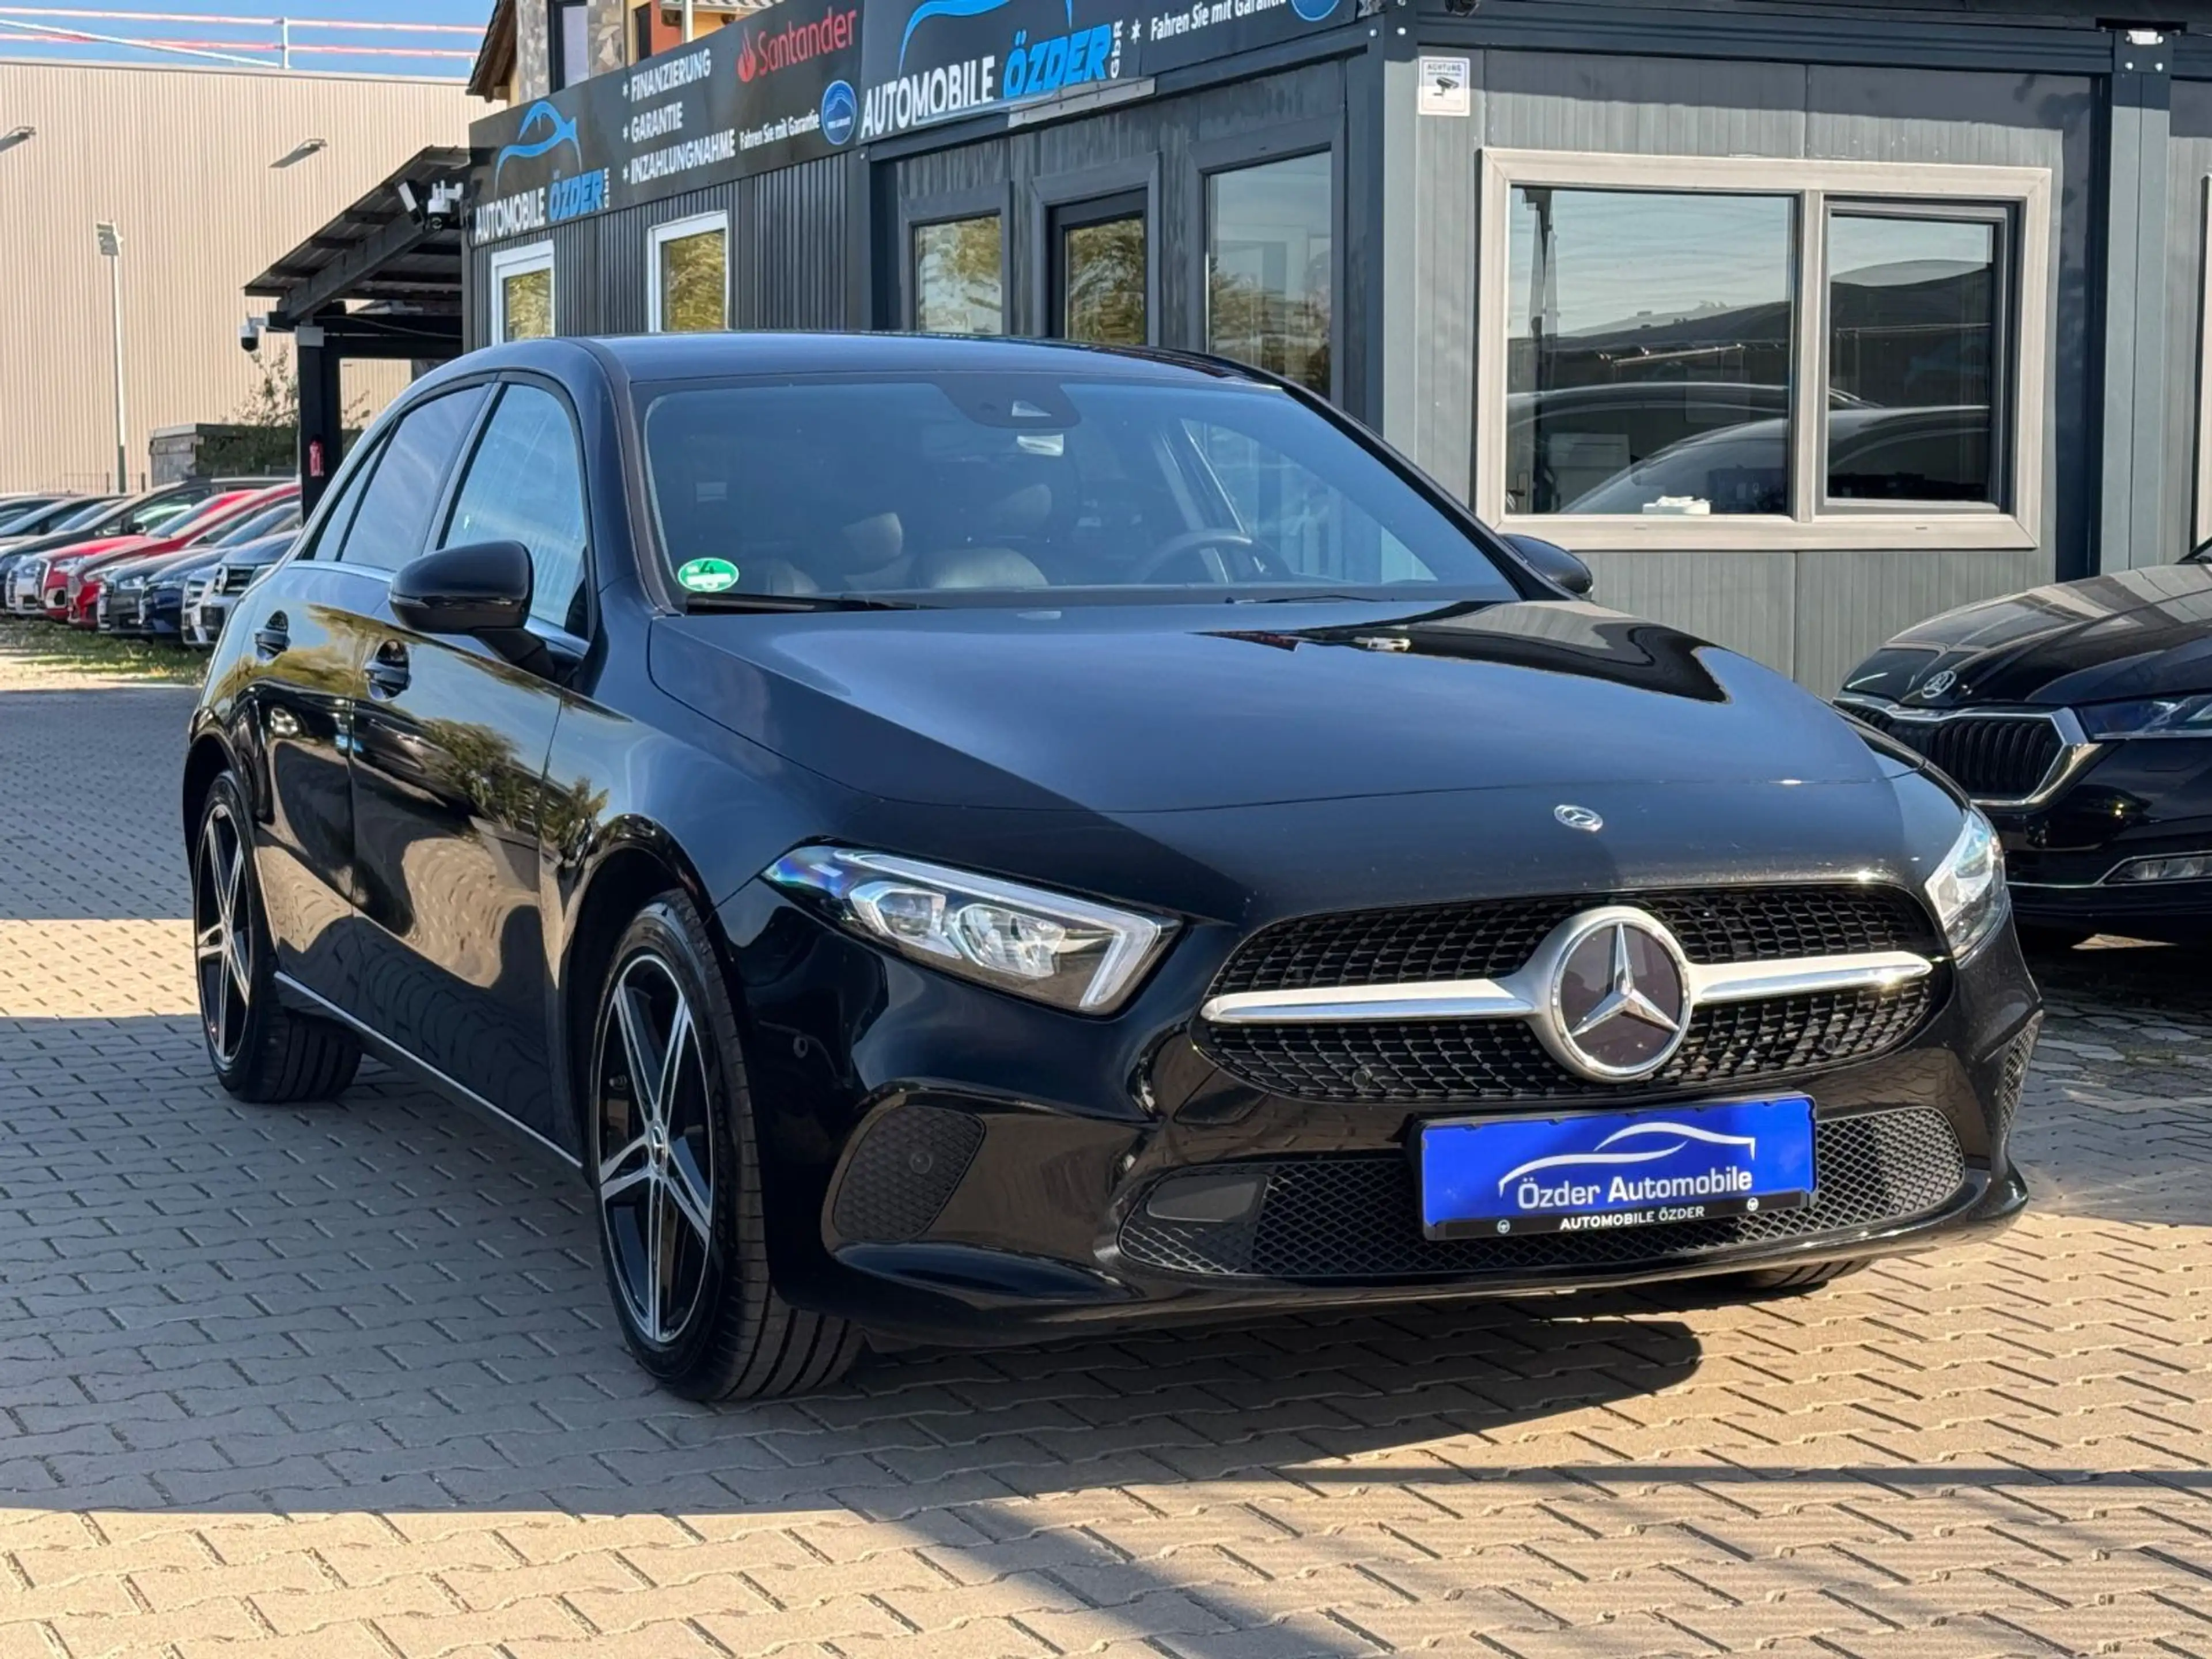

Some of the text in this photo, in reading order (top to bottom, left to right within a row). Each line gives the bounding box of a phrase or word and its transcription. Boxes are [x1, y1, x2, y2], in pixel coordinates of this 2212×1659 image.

[758, 6, 857, 76] Santander
[1150, 12, 1190, 41] Fahren
[1191, 1, 1209, 29] Sie
[1211, 0, 1232, 23] mit
[631, 48, 711, 103] FINANZIERUNG
[1110, 19, 1123, 78] GbR
[861, 24, 1111, 139] AUTOMOBILE ÖZDER
[631, 101, 683, 143] GARANTIE
[630, 128, 736, 184] INZAHLUNGNAHME
[475, 169, 604, 244] AUTOMOBILE ÖZDER
[1517, 1166, 1752, 1209] Özder Automobile
[1559, 1206, 1705, 1231] AUTOMOBILE ÖZDER
